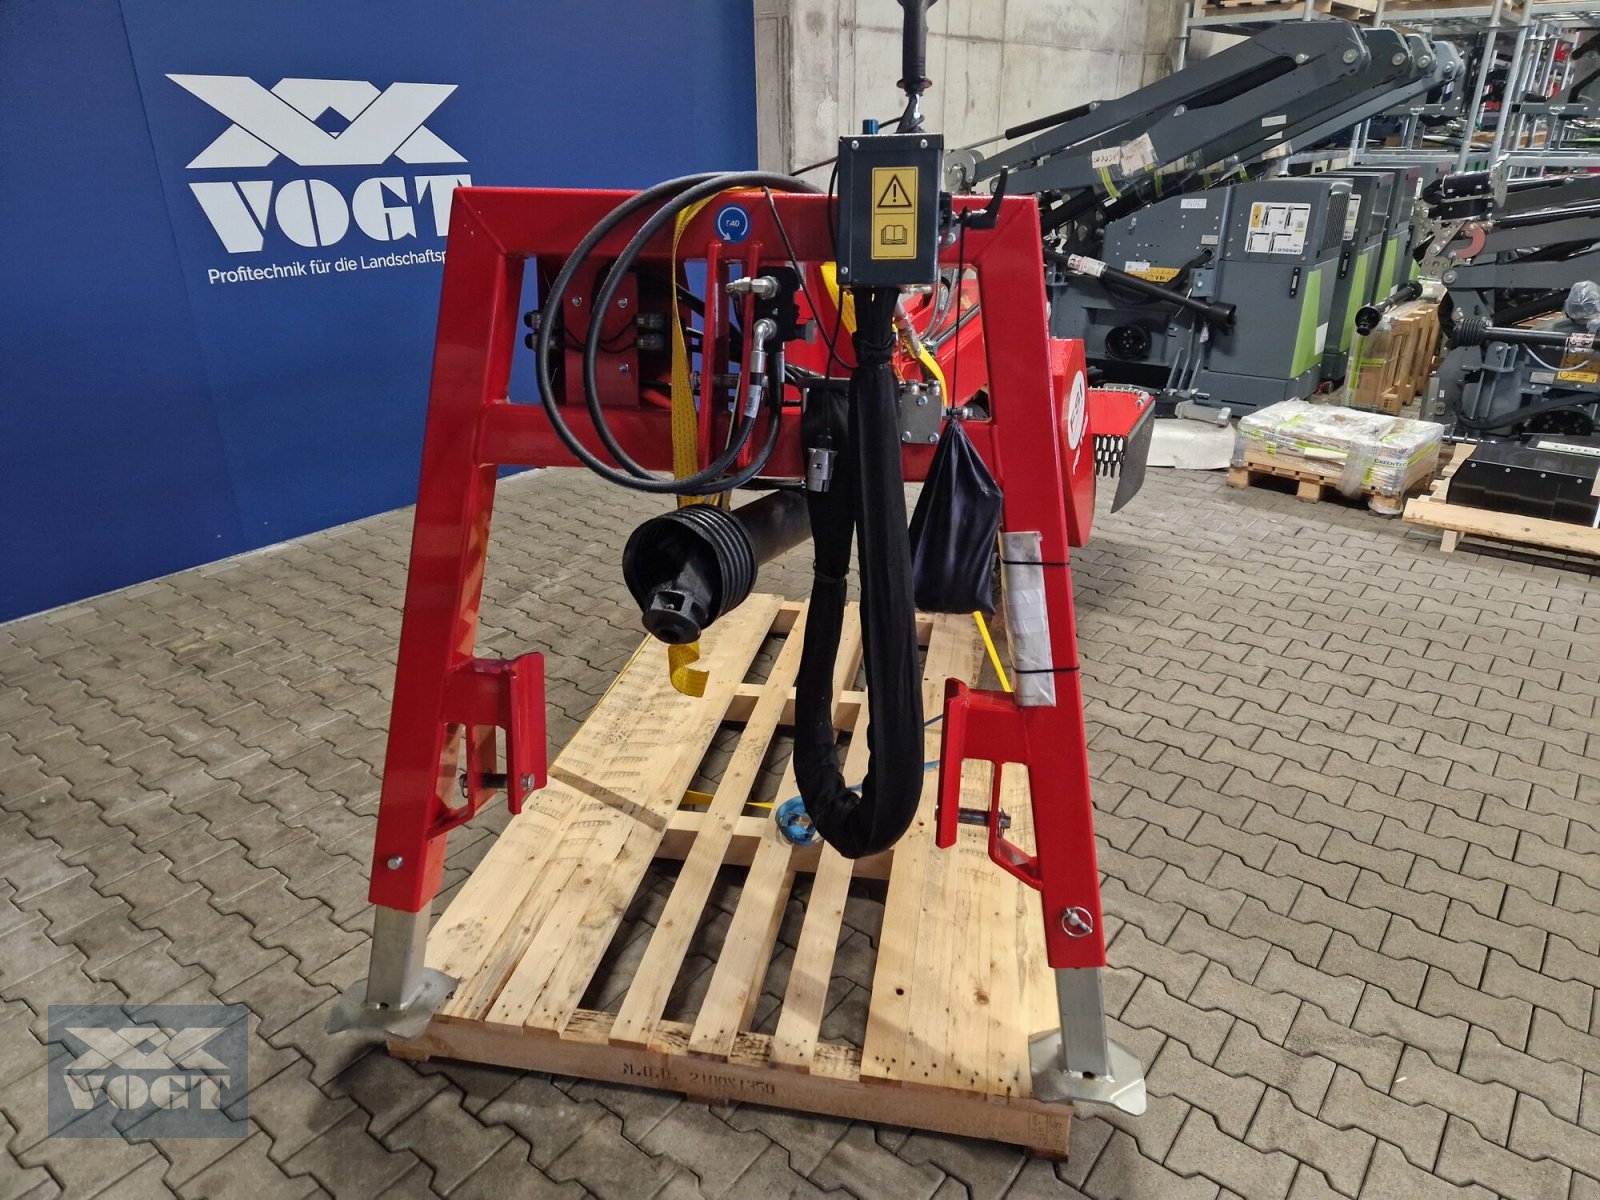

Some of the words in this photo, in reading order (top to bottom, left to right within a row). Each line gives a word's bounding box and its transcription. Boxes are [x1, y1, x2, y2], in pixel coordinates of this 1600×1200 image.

[188, 174, 471, 254] VOGT
[208, 261, 307, 285] Profitechnik
[309, 259, 331, 275] für
[335, 257, 358, 272] die
